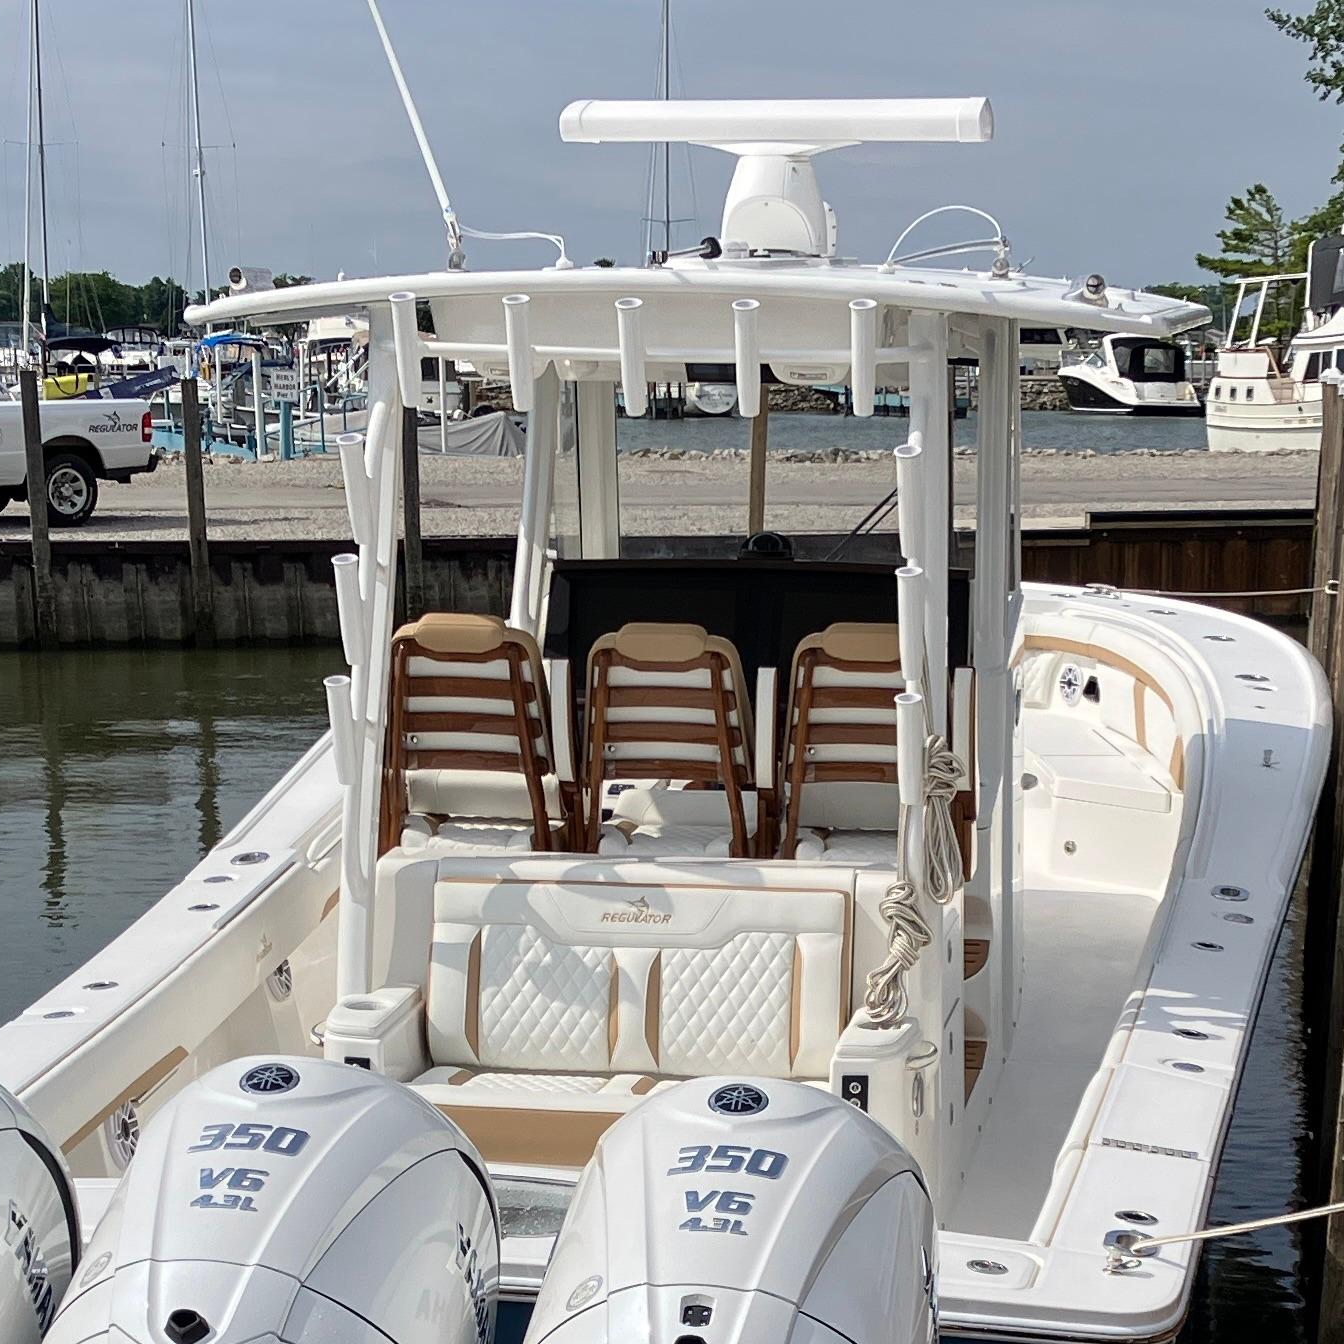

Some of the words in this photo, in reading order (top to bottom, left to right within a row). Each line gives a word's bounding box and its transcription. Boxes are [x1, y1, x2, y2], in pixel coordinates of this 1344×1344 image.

[89, 423, 138, 433] REGULATOR
[601, 912, 672, 924] REGULATOR
[187, 1123, 311, 1156] 350
[666, 1145, 789, 1179] 350
[200, 1167, 270, 1191] V6
[190, 1194, 258, 1211] 4.3L
[685, 1190, 756, 1215] V6
[679, 1217, 748, 1235] 4.3L
